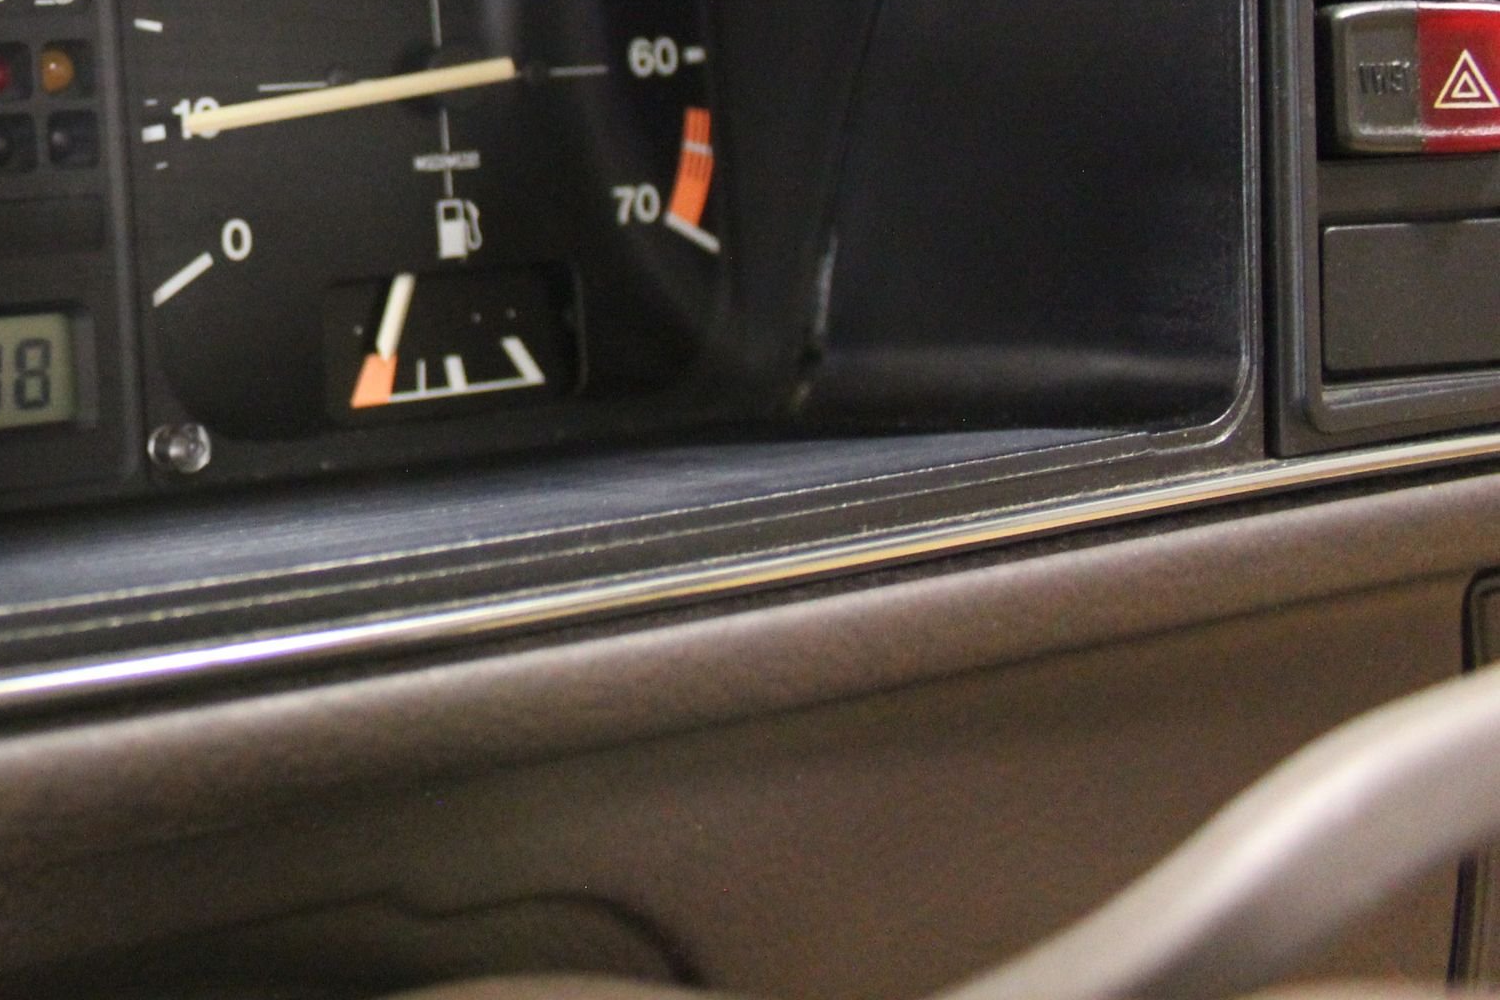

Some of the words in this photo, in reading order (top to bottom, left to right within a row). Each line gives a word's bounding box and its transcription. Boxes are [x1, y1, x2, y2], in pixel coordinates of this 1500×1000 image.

[628, 36, 679, 78] 60
[612, 183, 661, 225] 70
[221, 218, 254, 259] 0
